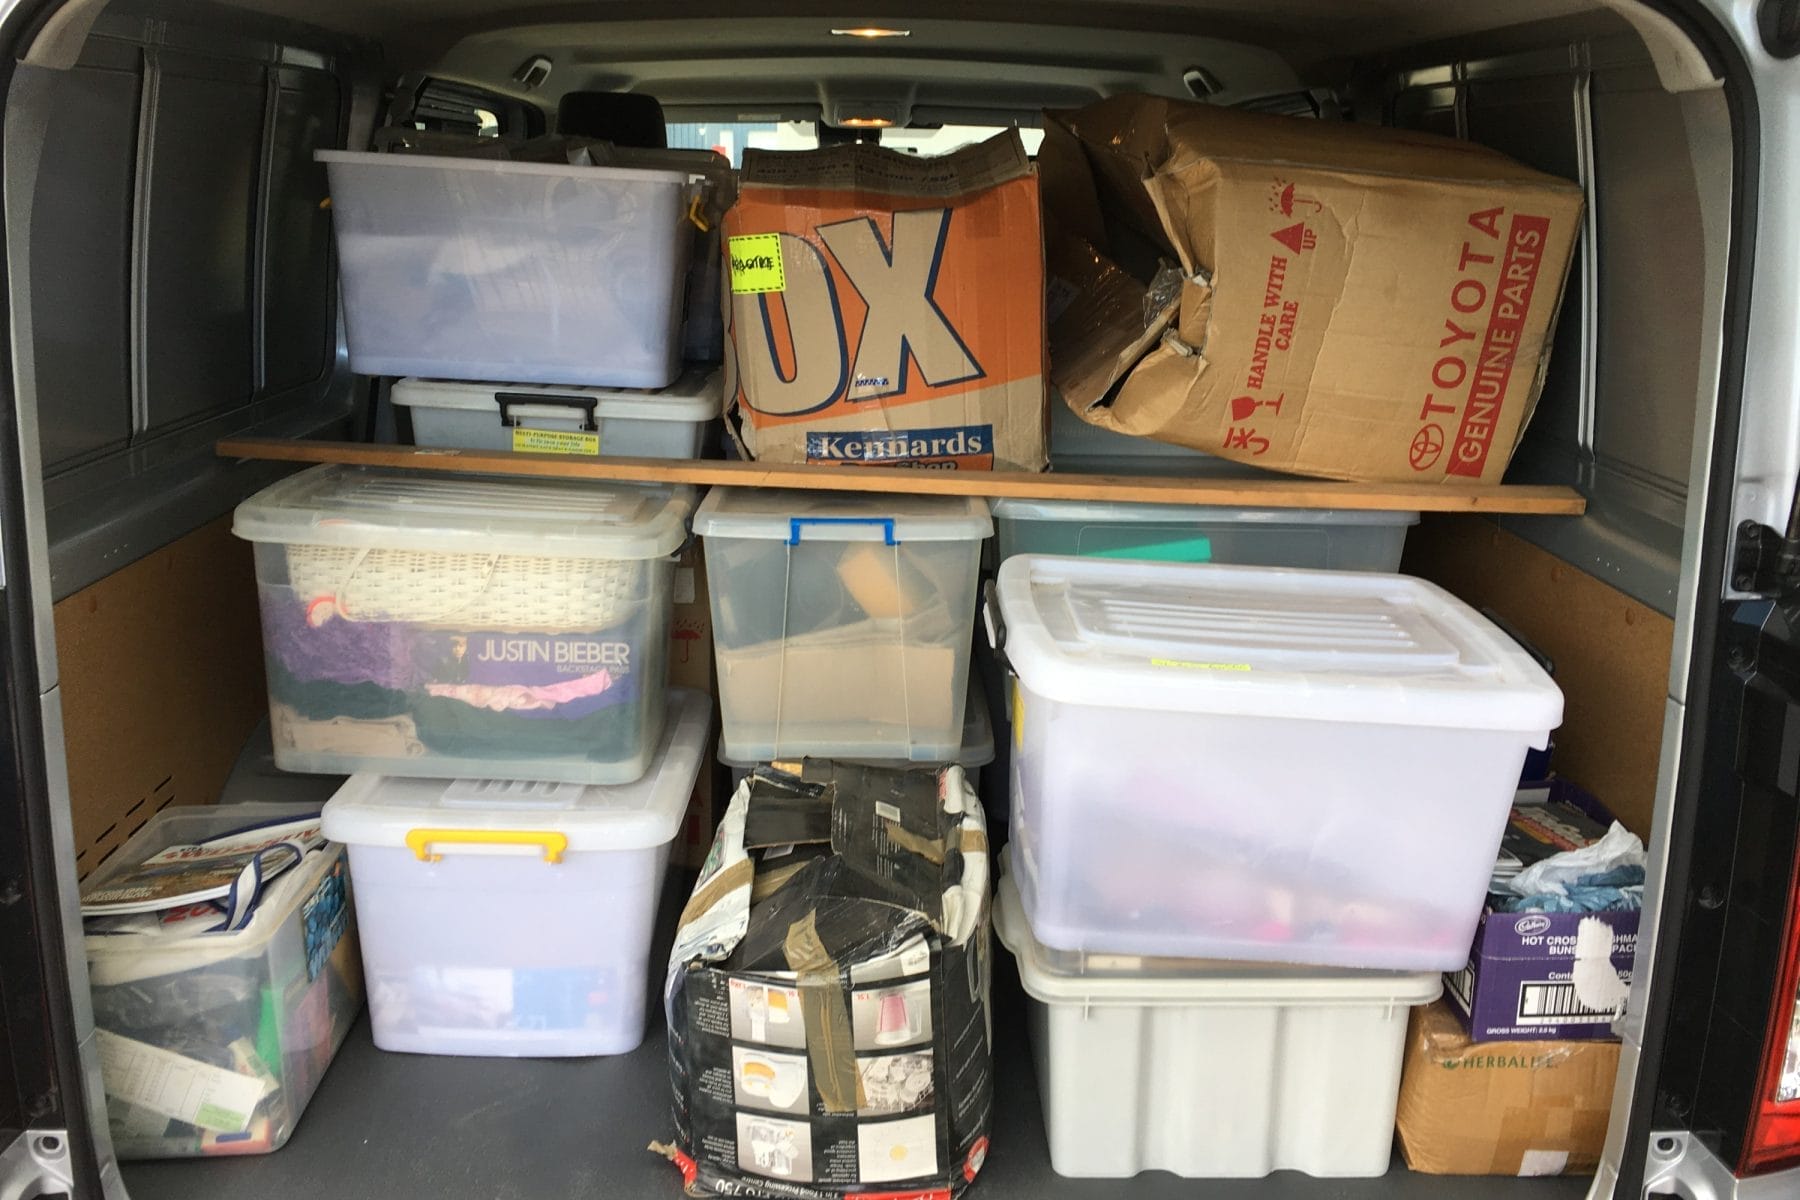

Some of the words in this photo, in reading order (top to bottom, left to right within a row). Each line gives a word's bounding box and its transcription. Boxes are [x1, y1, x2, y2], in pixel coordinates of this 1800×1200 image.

[1303, 228, 1317, 250] UP
[724, 207, 986, 417] OX
[1247, 313, 1277, 390] HANDLE
[1264, 255, 1288, 309] WITH
[1419, 206, 1505, 421] TOYOTA
[1275, 300, 1299, 351] CARE
[1457, 330, 1516, 463] GENUINE
[1498, 229, 1541, 320] PARTS
[820, 431, 983, 459] Kennards
[478, 639, 550, 662] JUSTIN
[554, 642, 630, 664] BIEBER
[1522, 936, 1544, 946] HOT
[1547, 936, 1578, 946] CROS
[1486, 1026, 1510, 1035] GROSS
[715, 1178, 742, 1197] 750
[741, 1176, 764, 1188] Centre
[764, 1179, 800, 1195] Processing
[800, 1187, 818, 1198] Food
